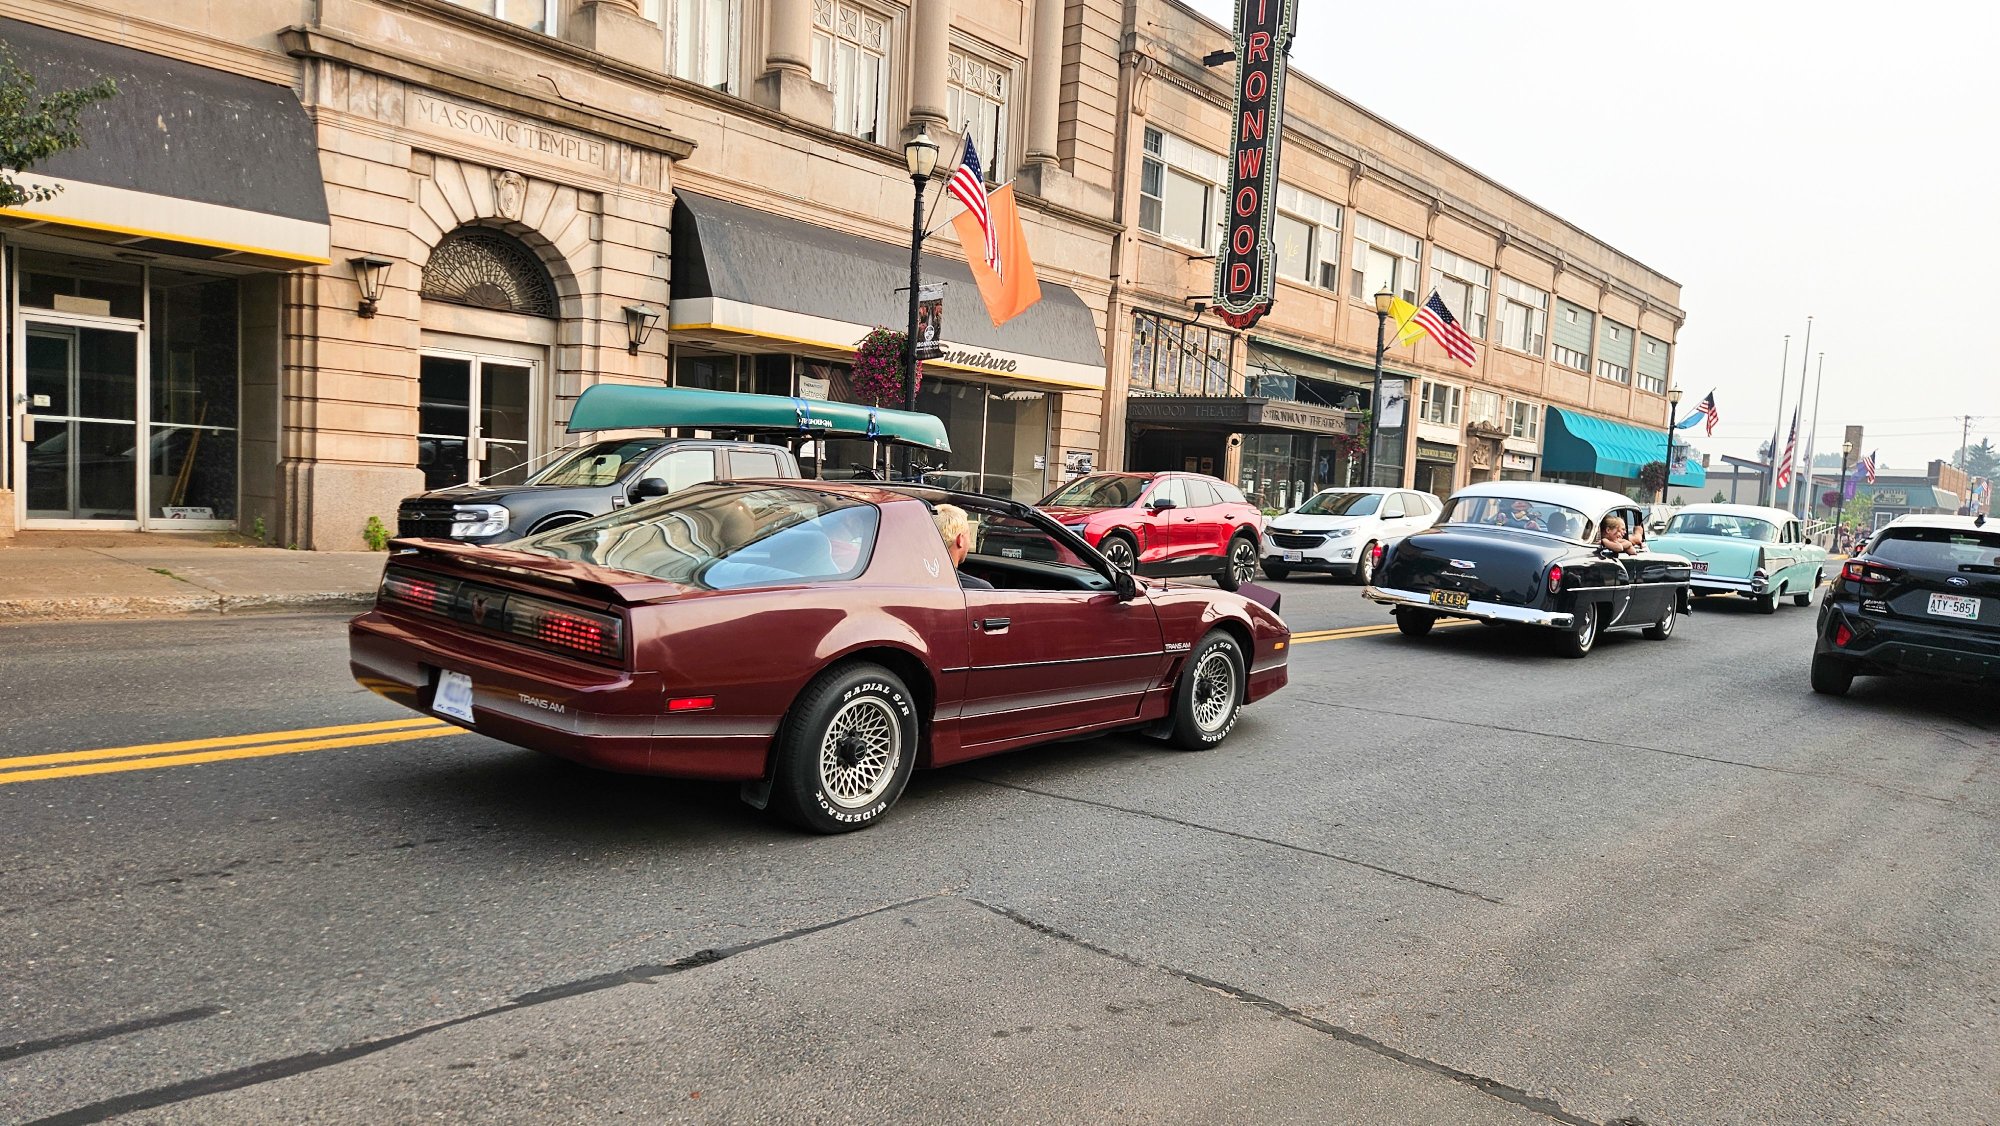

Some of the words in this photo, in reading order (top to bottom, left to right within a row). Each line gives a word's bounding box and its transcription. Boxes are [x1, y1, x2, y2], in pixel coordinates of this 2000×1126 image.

[418, 98, 519, 143] MASONIC
[524, 127, 600, 166] TEMPLE
[1230, 0, 1271, 294] IRONWOOD
[1194, 405, 1243, 417] THEATRE
[1309, 415, 1336, 428] THEATRE
[1930, 599, 1976, 615] ATY-5851
[1165, 642, 1183, 650] TRANS
[518, 693, 548, 708] TRANS
[549, 702, 565, 713] AM
[843, 682, 890, 702] RADIAL
[893, 693, 910, 716] S/R
[1201, 705, 1241, 742] WIDETRACK
[815, 790, 887, 822] WIDETRACK
